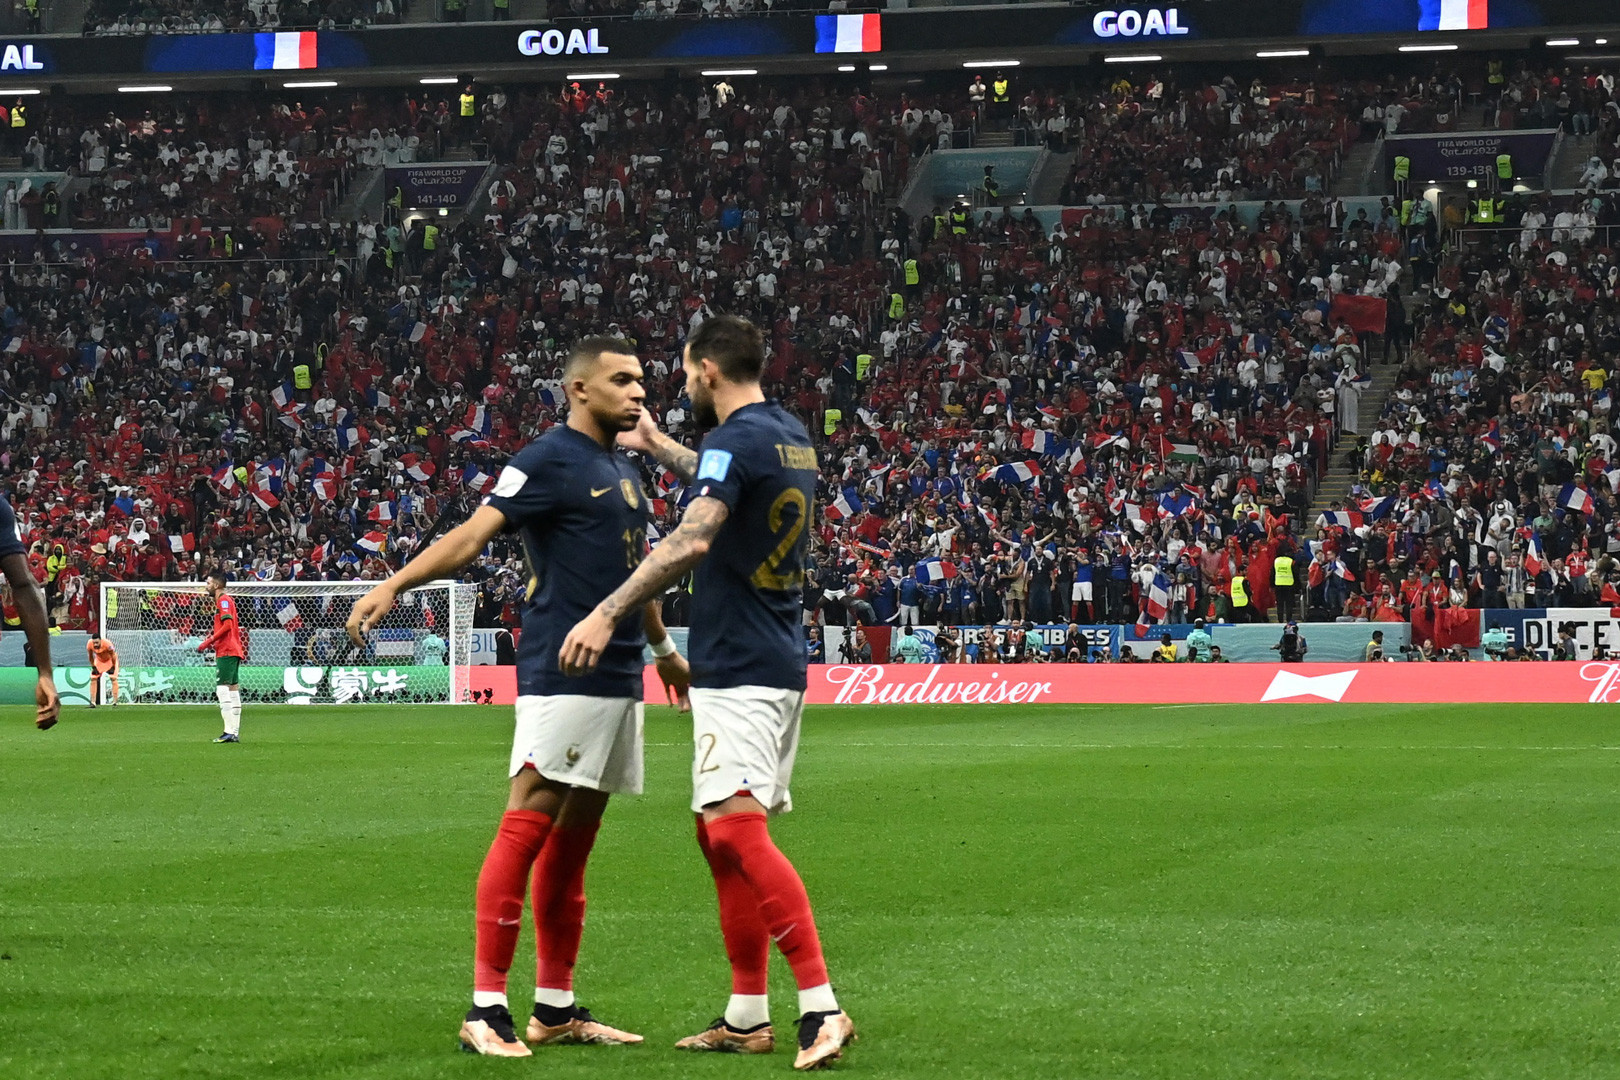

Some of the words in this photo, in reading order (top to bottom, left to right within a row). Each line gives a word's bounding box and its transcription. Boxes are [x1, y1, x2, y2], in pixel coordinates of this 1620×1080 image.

[1093, 8, 1189, 37] GOAL
[517, 28, 609, 56] GOAL
[1, 44, 44, 70] AL
[1437, 140, 1455, 148] FIFA
[1455, 139, 1485, 147] WORLD
[1485, 138, 1501, 146] CUP
[424, 169, 451, 177] WORLD
[1446, 165, 1493, 176] 139-138
[417, 194, 457, 204] 141-140
[826, 664, 1052, 704] Budweiser
[698, 733, 720, 775] 2
